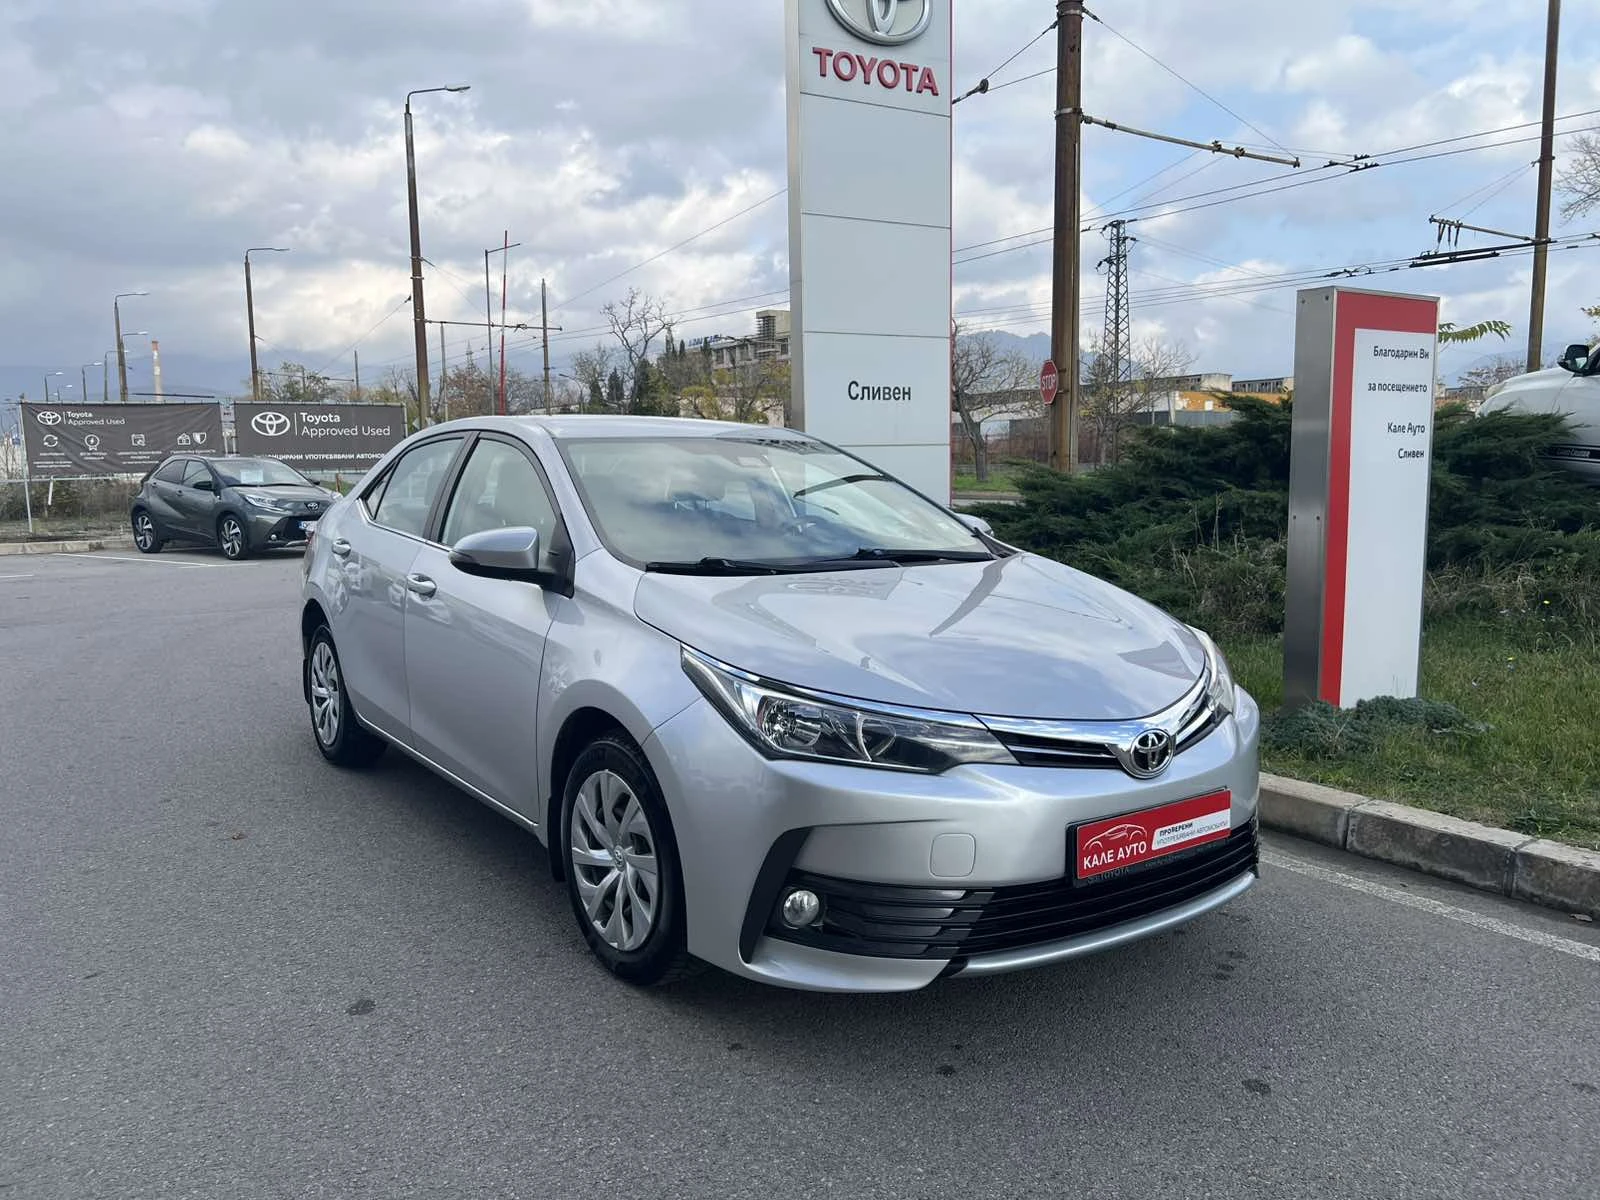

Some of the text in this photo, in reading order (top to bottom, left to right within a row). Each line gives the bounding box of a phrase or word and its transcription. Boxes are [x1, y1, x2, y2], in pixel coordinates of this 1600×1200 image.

[812, 46, 939, 96] TOYOTA
[1373, 346, 1430, 360] Благодарим Ви
[1041, 374, 1057, 391] STOP
[1368, 382, 1428, 393] за посещението
[848, 380, 911, 401] Сливен
[66, 411, 93, 419] Toyota
[68, 418, 104, 426] Approved
[300, 412, 341, 426] Toyota
[301, 425, 391, 438] Approved Used
[1388, 422, 1426, 436] Кале Ауто
[1398, 448, 1424, 459] Сливен
[1160, 822, 1193, 837] ПРОВЕРЕНИ
[1084, 841, 1147, 870] КАЛЕ АУТО
